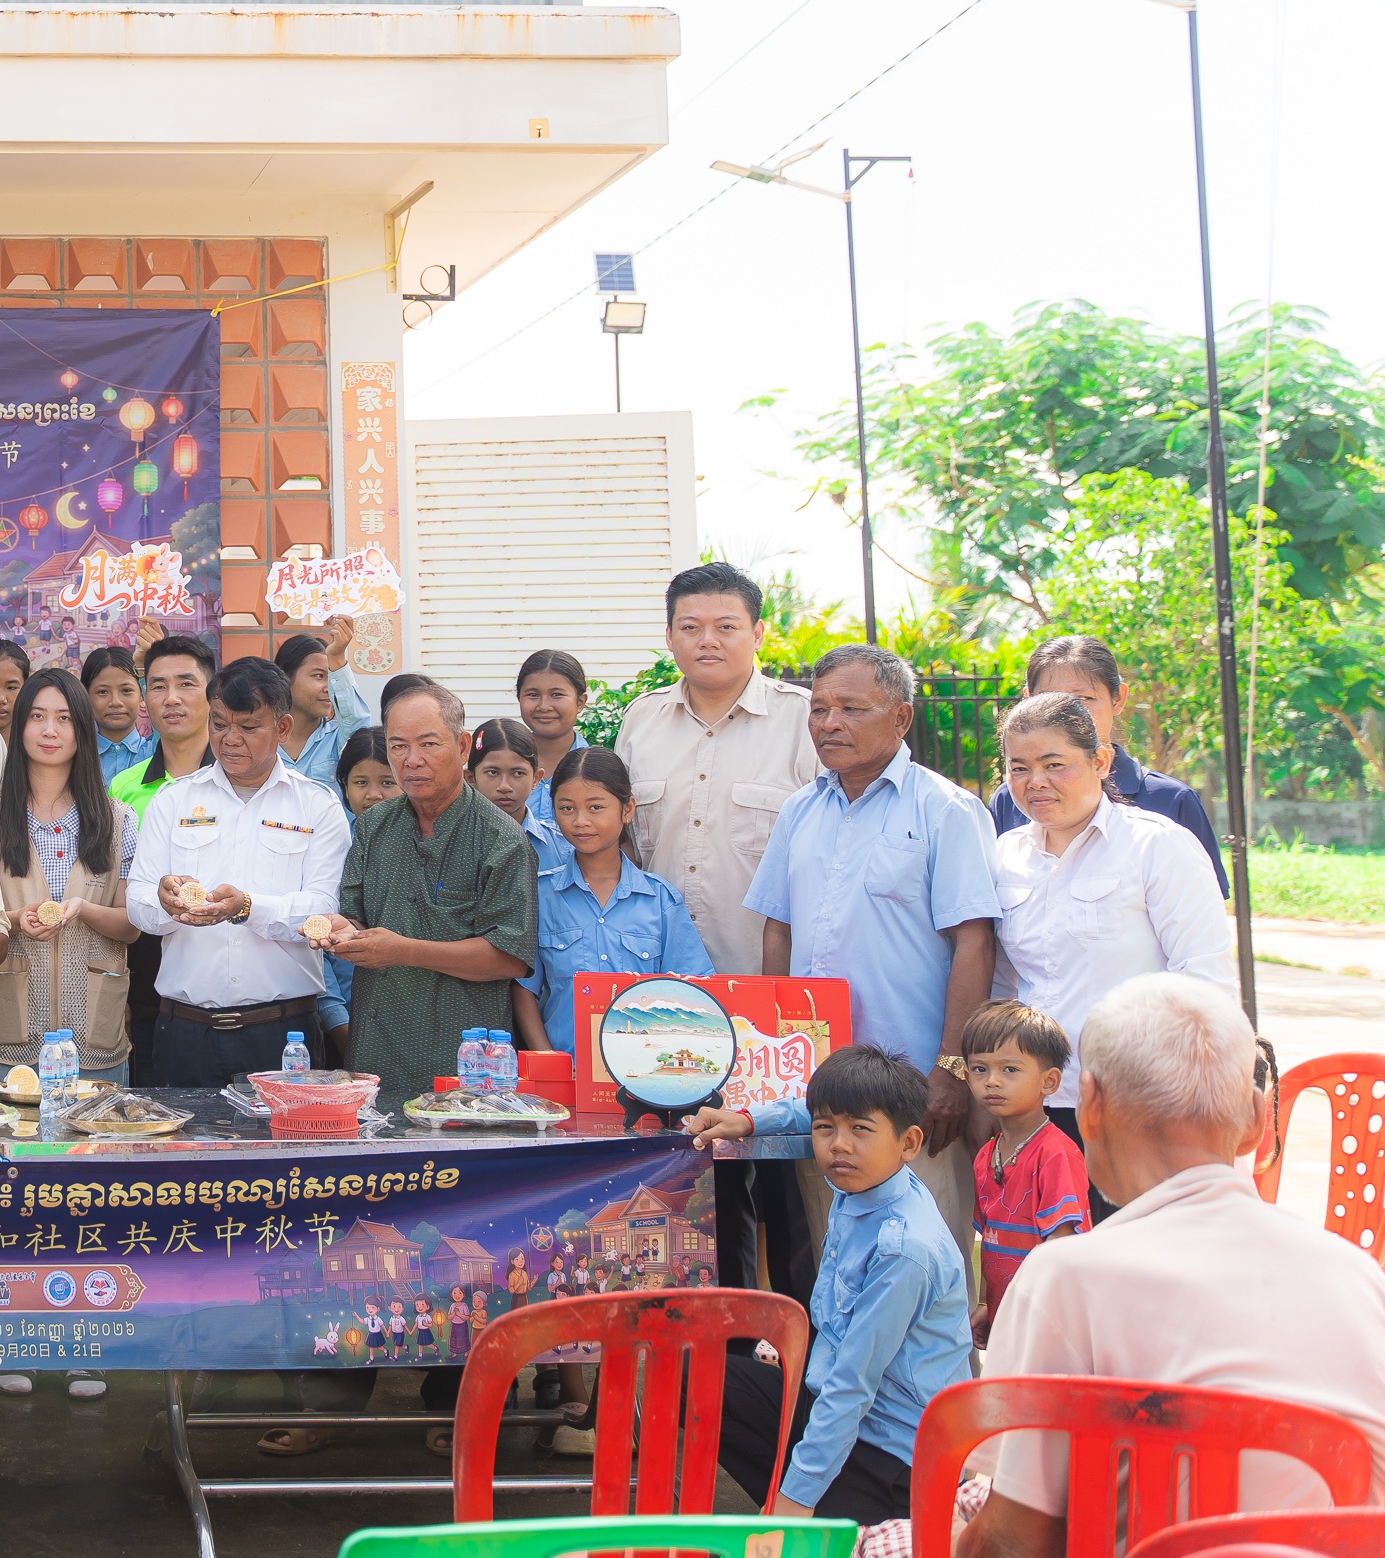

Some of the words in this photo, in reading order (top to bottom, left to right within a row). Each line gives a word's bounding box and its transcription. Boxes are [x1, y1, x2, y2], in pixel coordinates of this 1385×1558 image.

[355, 385, 385, 554] 家兴人兴事
[273, 555, 375, 596] 月光所照
[635, 1219, 660, 1227] SCHOOL
[57, 1344, 67, 1357] &
[73, 1343, 102, 1358] 21日
